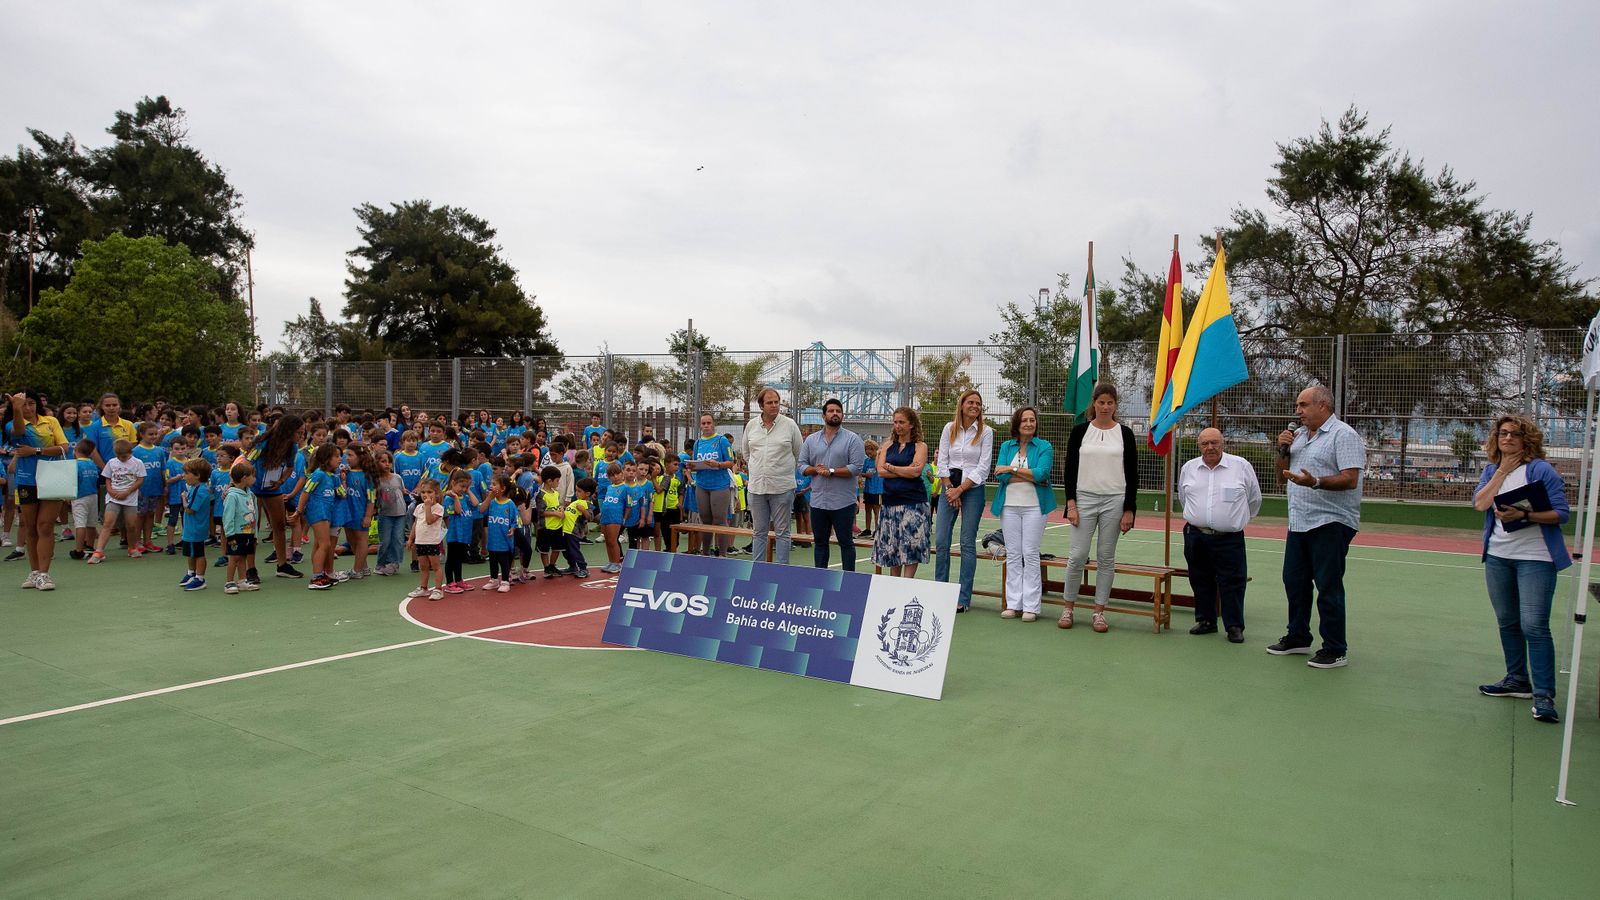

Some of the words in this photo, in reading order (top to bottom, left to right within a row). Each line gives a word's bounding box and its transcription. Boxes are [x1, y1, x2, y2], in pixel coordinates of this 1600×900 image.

[145, 461, 161, 470] EVO
[622, 586, 710, 617] EVOS
[731, 595, 758, 610] Club
[760, 600, 775, 612] de
[777, 601, 837, 621] Atletismo
[726, 612, 758, 628] Bahía
[760, 618, 775, 630] de
[776, 619, 835, 639] Algeciras
